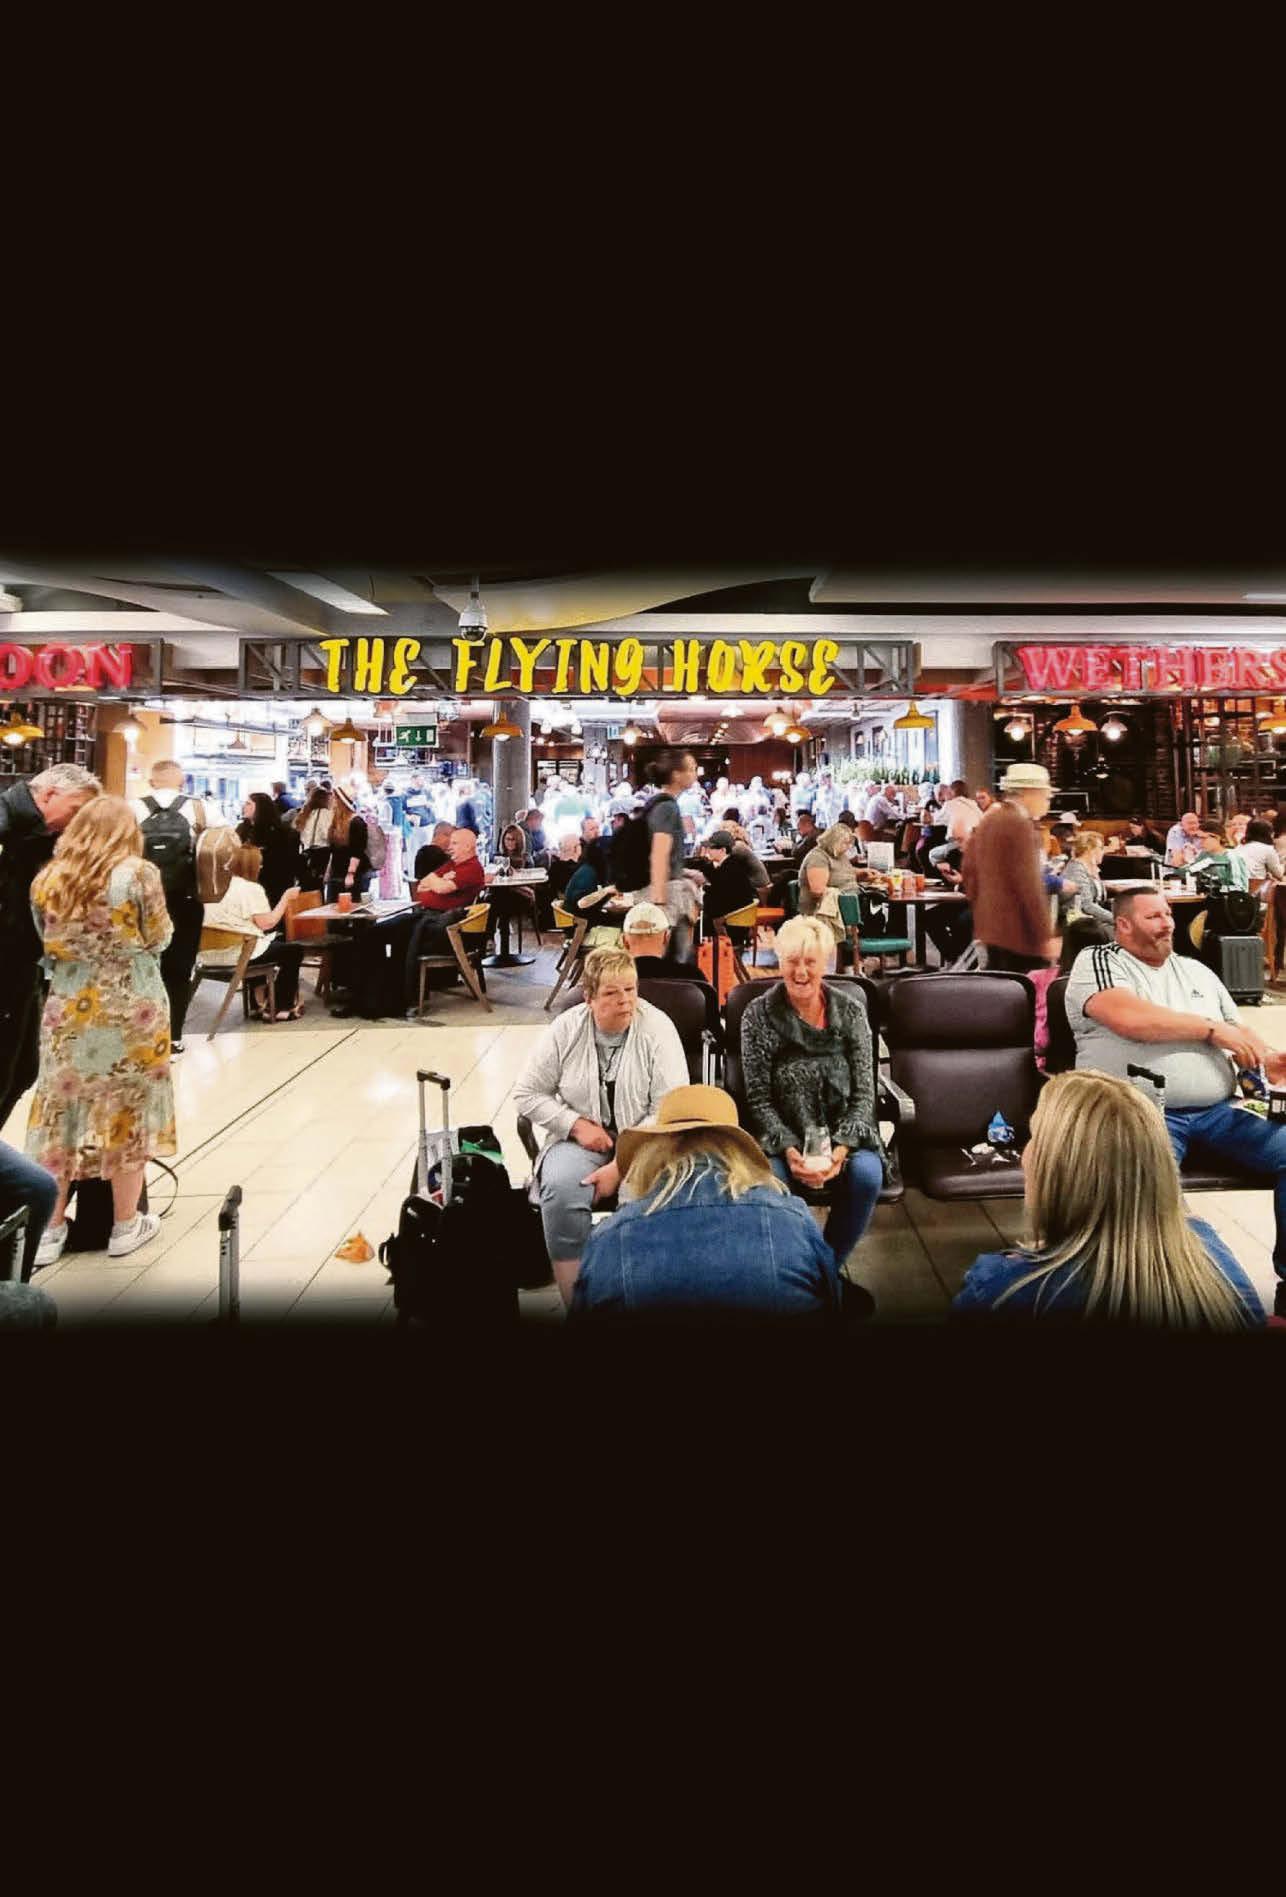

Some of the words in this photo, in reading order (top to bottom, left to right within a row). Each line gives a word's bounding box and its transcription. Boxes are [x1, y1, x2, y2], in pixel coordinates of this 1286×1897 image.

[319, 637, 421, 695] THE
[452, 637, 645, 697] FLYING
[673, 638, 841, 696] HORSE
